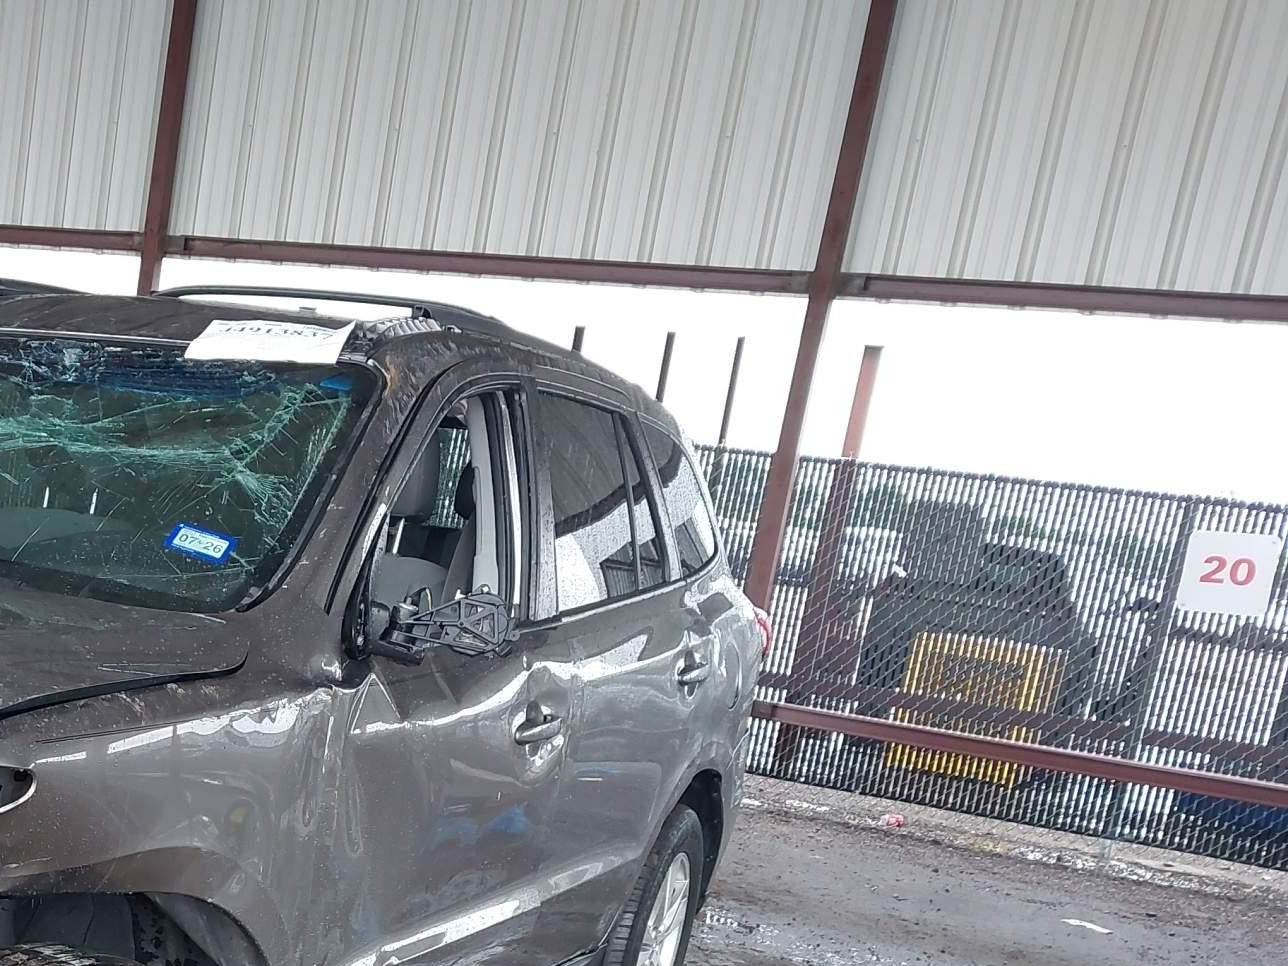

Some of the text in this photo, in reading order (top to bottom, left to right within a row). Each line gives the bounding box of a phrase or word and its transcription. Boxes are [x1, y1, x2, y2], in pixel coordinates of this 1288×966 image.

[178, 533, 199, 545] 07
[202, 541, 223, 554] 26
[1199, 556, 1256, 586] 20
